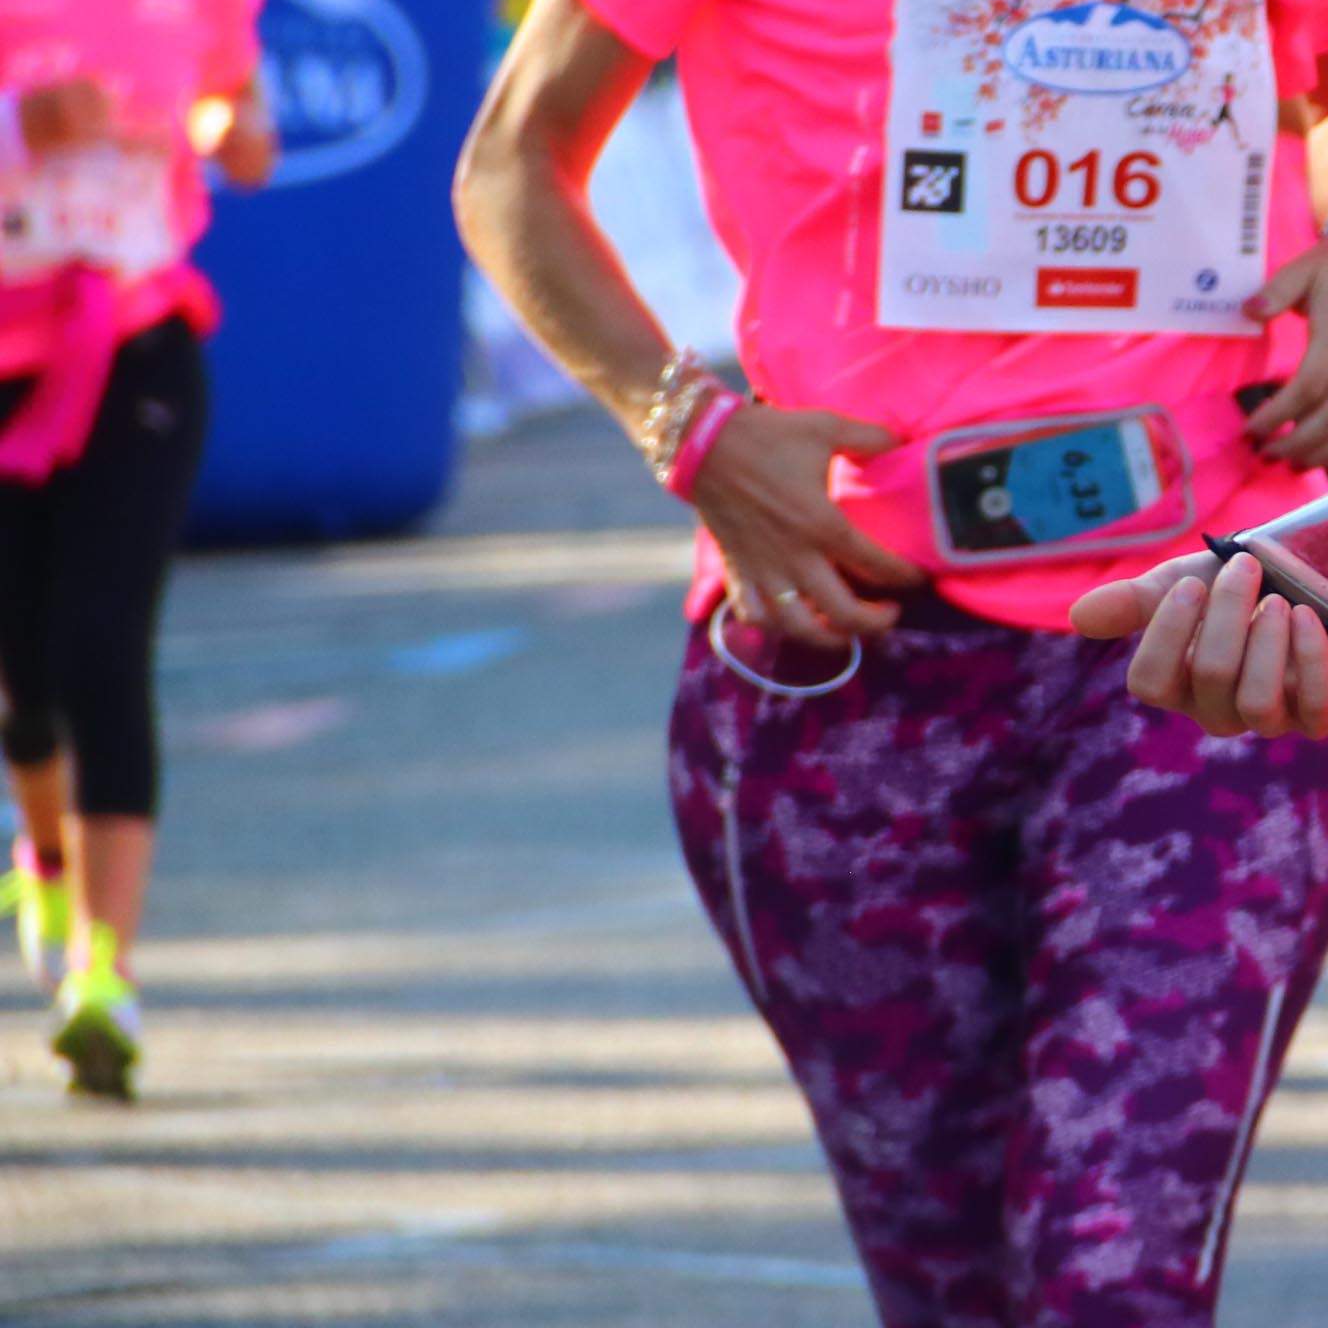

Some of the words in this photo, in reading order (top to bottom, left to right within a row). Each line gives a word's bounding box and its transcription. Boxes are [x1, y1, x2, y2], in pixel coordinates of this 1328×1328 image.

[1019, 34, 1176, 71] ASTURIANA
[1014, 148, 1163, 210] 016
[1036, 225, 1127, 254] 13609
[904, 273, 1003, 300] OYSHO
